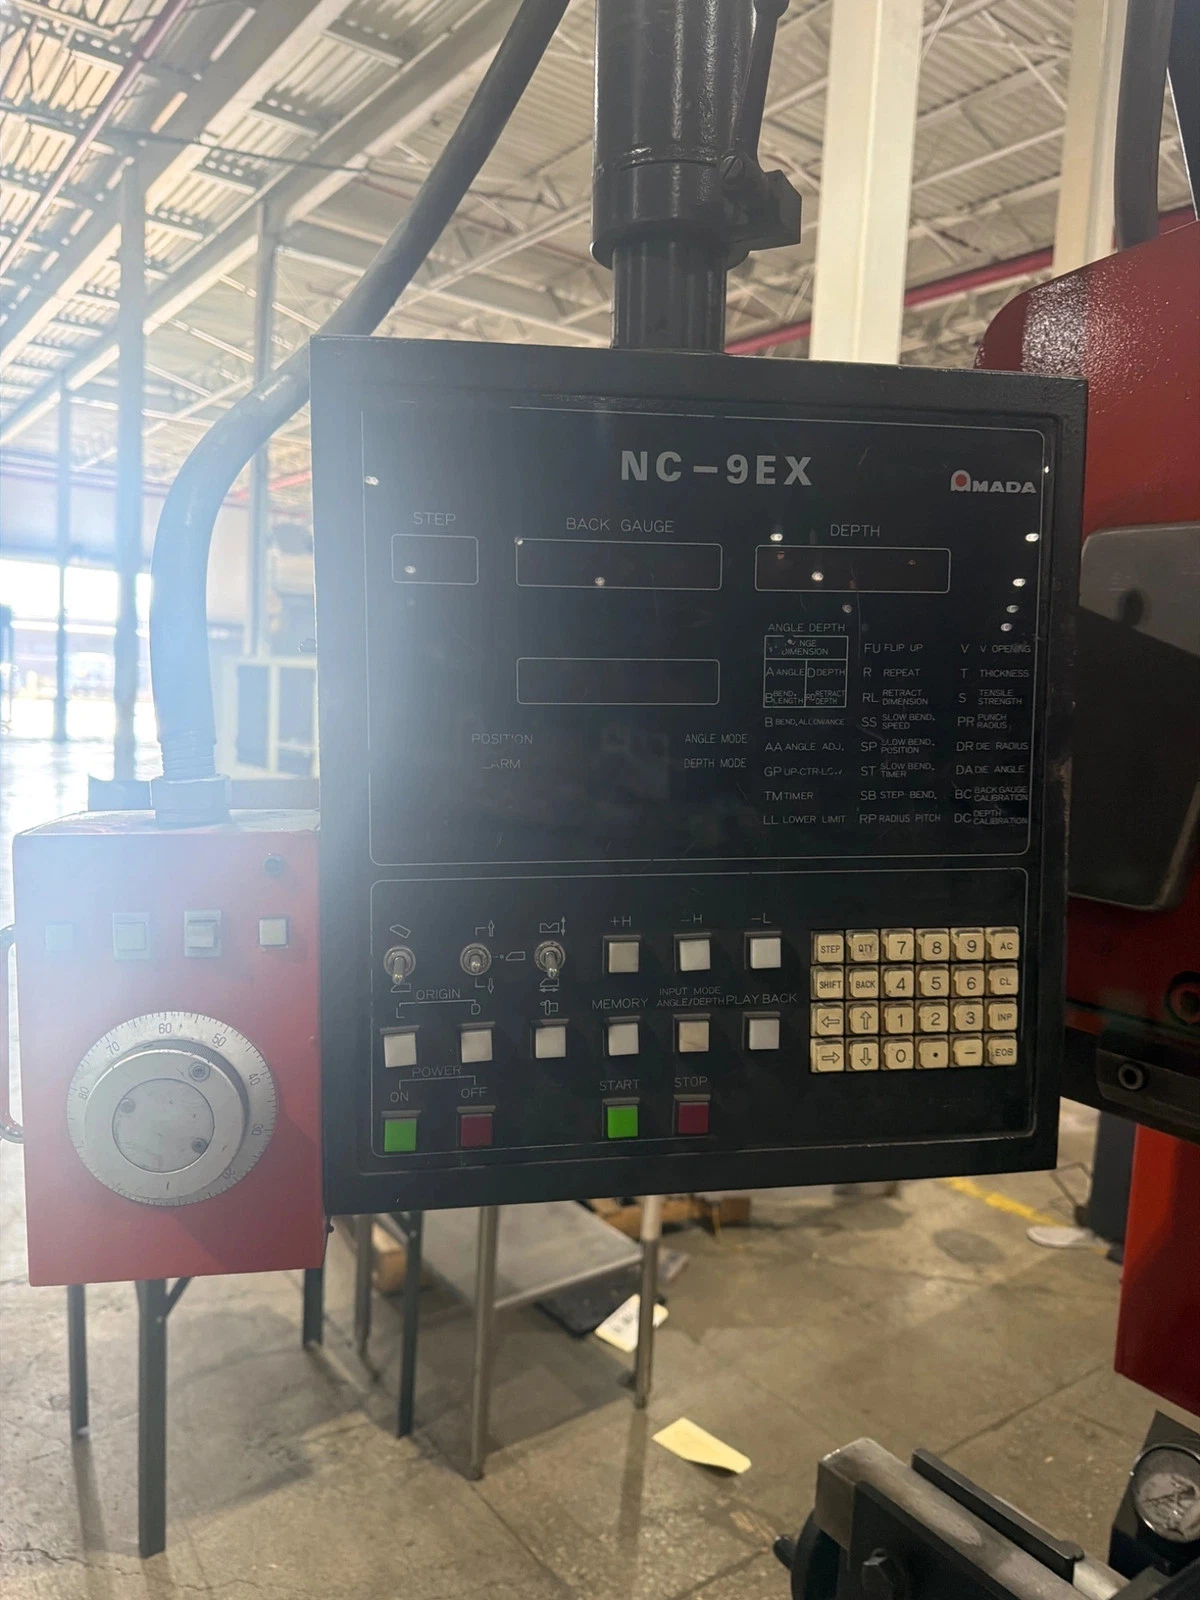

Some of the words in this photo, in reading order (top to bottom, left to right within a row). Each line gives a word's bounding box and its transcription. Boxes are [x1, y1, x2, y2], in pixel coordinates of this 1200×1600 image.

[413, 511, 456, 526] STEP
[566, 517, 610, 531] BACK
[620, 519, 674, 533] GAUGE
[830, 524, 880, 537] DEPTH
[767, 623, 805, 632] ANGLE
[808, 623, 846, 632] DEPTH
[781, 647, 829, 656] DIMENSION
[864, 643, 881, 654] FU
[884, 643, 905, 652] FLIP
[909, 643, 924, 652] UP
[960, 643, 970, 654] V
[980, 645, 987, 653] V
[765, 666, 775, 677] A
[776, 668, 805, 676] ANGLE
[807, 667, 816, 678] D
[816, 668, 846, 676] DEPTH
[863, 666, 872, 677] R
[883, 668, 921, 677] REPEAT
[960, 668, 969, 678] T
[980, 669, 1029, 678] THICKNESS
[765, 692, 773, 703] B
[815, 689, 845, 697] RETRACT
[862, 692, 879, 703] RL
[882, 689, 922, 697] RETRACT
[958, 692, 967, 704] S
[979, 689, 1014, 697] TENSILE
[815, 697, 838, 705] DEPTH
[882, 697, 928, 706] DIMENSION
[978, 697, 1023, 705] STRENGTH
[764, 717, 773, 727] B
[861, 716, 877, 728] SS
[882, 713, 907, 721] SLOW
[908, 713, 936, 721] BEND.
[957, 716, 975, 727] PR
[977, 713, 1007, 721] PUNCH
[882, 721, 911, 730] SPEED
[976, 721, 1007, 729] RADIUS
[684, 733, 717, 744] ANGLE
[720, 733, 748, 744] MODE
[880, 738, 907, 746] SLOW
[907, 738, 935, 746] BEND.
[764, 742, 783, 752] AA
[784, 742, 817, 751] ANGLE
[822, 742, 845, 751] ADJ.
[860, 741, 878, 752] SP
[880, 746, 920, 754] POSITION
[956, 741, 974, 752] DR
[995, 741, 1029, 751] RADIUS
[481, 759, 521, 769] ARM
[683, 758, 715, 768] DEPTH
[719, 758, 747, 768] MODE
[880, 762, 906, 770] SLOW
[907, 762, 935, 771] BEND.
[763, 766, 782, 777] GP
[860, 765, 877, 776] ST
[881, 770, 907, 778] TIMER
[955, 764, 974, 775] DA
[994, 765, 1025, 774] ANGLE
[954, 788, 972, 800] BC
[974, 786, 998, 794] BACK
[999, 785, 1028, 794] GAUGE
[764, 790, 783, 801] TM
[783, 791, 814, 800] TIMER
[860, 790, 877, 801] SB
[880, 790, 905, 799] STEP
[909, 790, 937, 800] BEND.
[974, 794, 1028, 802] CALIBRATION
[859, 813, 877, 824] RP
[879, 814, 911, 823] RADIUS
[915, 813, 941, 822] PITCH
[954, 812, 972, 824] DC
[973, 809, 1002, 817] DEPTH
[763, 815, 779, 825] LL
[782, 815, 817, 823] LOWER
[822, 815, 846, 823] LIMIT
[973, 817, 1028, 825] CALIBRATION
[610, 916, 632, 926] +H
[820, 945, 841, 954] STEP
[858, 944, 874, 953] QTY
[896, 940, 907, 955] 7
[931, 941, 942, 955] 8
[966, 939, 977, 953] 9
[1000, 942, 1013, 951] AC
[819, 980, 842, 990] SHIFT
[855, 979, 876, 989] BACK
[895, 977, 906, 991] 4
[931, 976, 942, 991] 5
[966, 976, 977, 990] 6
[1000, 978, 1012, 986] CL
[416, 988, 461, 1001] ORIGIN
[659, 987, 687, 996] INPUT
[694, 986, 721, 995] MODE
[592, 999, 648, 1010] MEMORY
[656, 997, 726, 1008] ANGLE/DEPTH
[471, 1005, 481, 1016] D
[897, 1013, 903, 1028] 1
[930, 1012, 941, 1026] 2
[965, 1011, 976, 1025] 3
[997, 1013, 1013, 1022] INP
[158, 1022, 172, 1034] 60
[211, 1032, 227, 1047] 50
[106, 1041, 120, 1055] 70
[895, 1049, 906, 1063] 0
[412, 1065, 462, 1077] POWER
[248, 1073, 261, 1086] 40
[674, 1077, 708, 1088] STOP
[600, 1080, 640, 1091] START
[78, 1086, 90, 1100] 80
[390, 1092, 409, 1102] ON
[461, 1087, 487, 1098] OFF
[251, 1123, 264, 1136] 30
